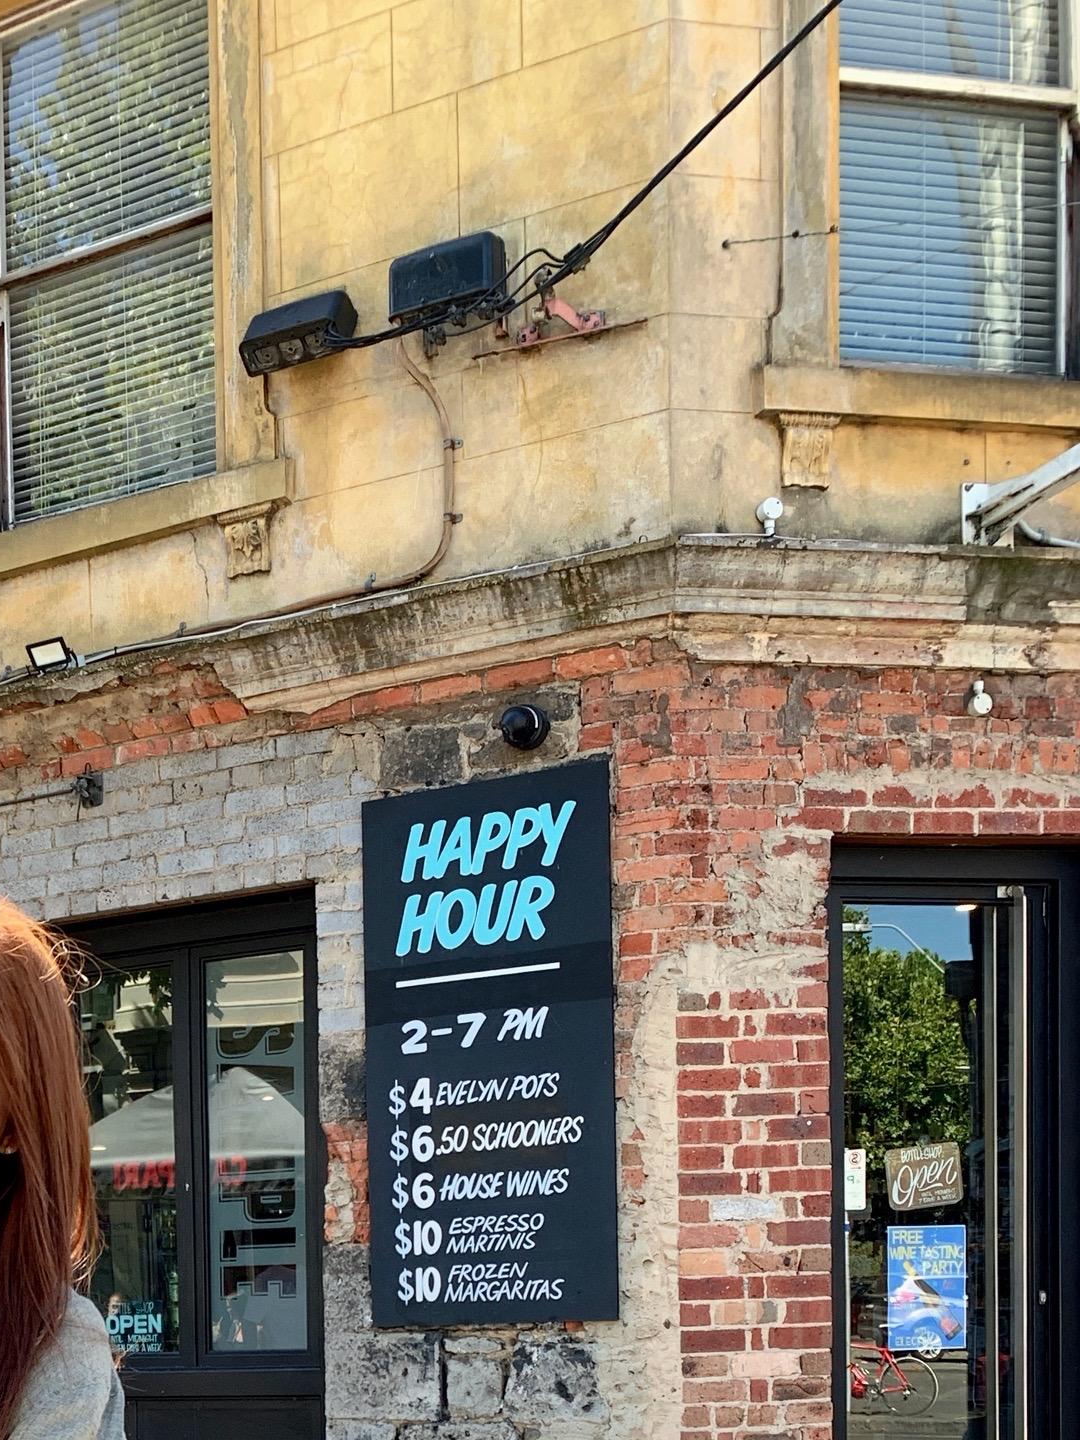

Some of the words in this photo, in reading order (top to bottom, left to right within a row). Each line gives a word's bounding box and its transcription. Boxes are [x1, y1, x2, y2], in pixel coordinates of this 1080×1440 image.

[400, 800, 577, 884] HAPPY
[395, 875, 556, 957] HOUR
[400, 1012, 487, 1055] 2-7
[497, 1006, 550, 1042] PM
[388, 1077, 434, 1121] $4
[435, 1077, 509, 1107] EVELYN
[506, 1072, 560, 1101] POTS
[389, 1124, 469, 1167] $6.50
[471, 1115, 585, 1152] SCHOONERS
[391, 1171, 436, 1214] $6
[438, 1171, 505, 1202] HOUSE
[506, 1168, 570, 1198] WINES
[892, 1156, 958, 1208] Open
[394, 1218, 443, 1259] $10
[448, 1213, 545, 1235] ESPRESSO
[446, 1231, 537, 1255] MARTINIS
[889, 1246, 917, 1260] WINE
[918, 1244, 964, 1260] TASTING
[892, 1230, 924, 1245] FREE
[398, 1266, 442, 1306] $10
[447, 1261, 529, 1284] FROZEN
[443, 1278, 565, 1303] MARGARITAS
[922, 1260, 964, 1277] PARTY
[106, 1314, 162, 1335] OPEN
